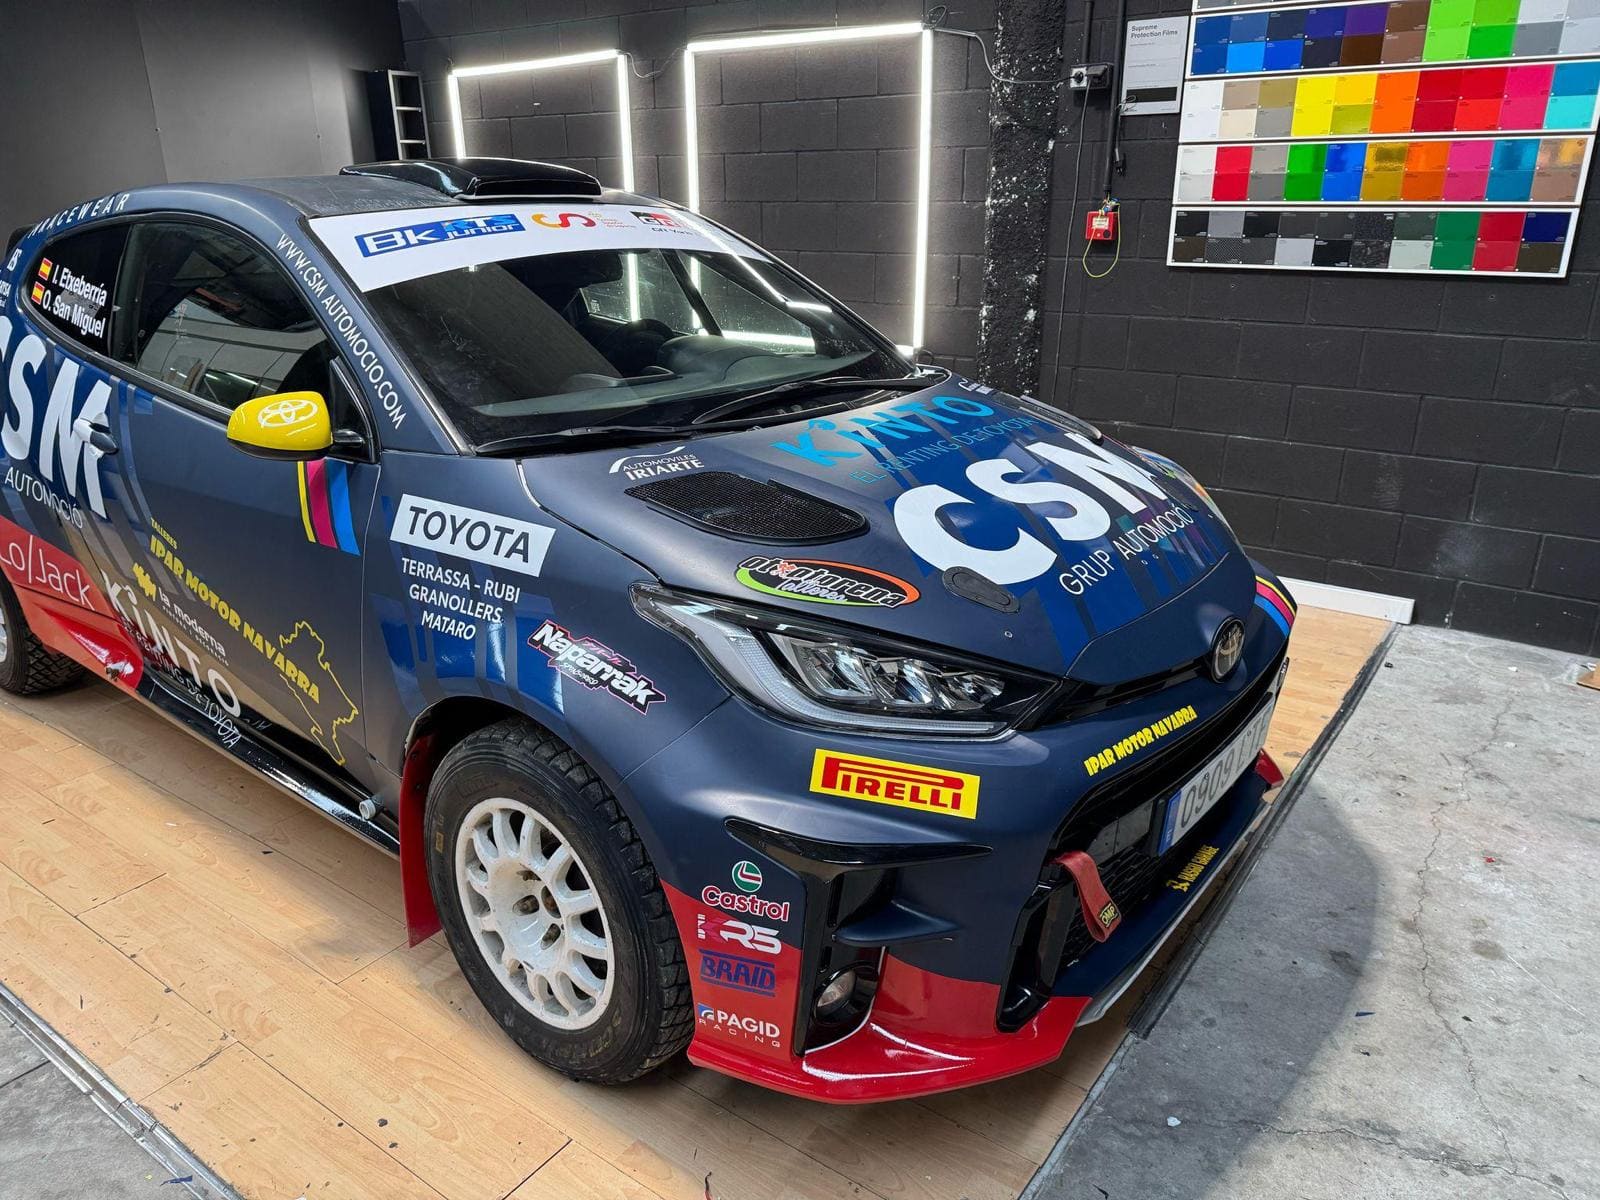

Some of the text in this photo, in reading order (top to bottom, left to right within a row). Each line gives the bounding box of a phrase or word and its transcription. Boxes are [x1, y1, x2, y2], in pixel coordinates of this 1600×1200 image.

[1131, 24, 1158, 32] Supreme
[58, 267, 108, 307] Etxeberría
[42, 289, 52, 312] O.
[53, 294, 71, 321] San
[71, 304, 107, 338] Miguel
[321, 294, 407, 430] AUTOMOCIO.COM
[623, 453, 697, 472] AUTOMOVILES
[625, 459, 705, 480] IRIARTE
[876, 436, 961, 475] RENTING
[893, 432, 1169, 585] CSM
[151, 518, 178, 550] TALLERES
[409, 505, 530, 563] TOYOTA
[1059, 502, 1194, 595] GRUP AUTOMOCIÓ
[401, 557, 471, 591] TERRASSA
[483, 578, 521, 604] RUBI
[150, 535, 185, 579] IPAR
[185, 568, 241, 631] MOTOR
[243, 622, 320, 704] NAVARRA
[409, 583, 504, 624] GRANOLLERS
[173, 602, 227, 657] moderna
[421, 610, 477, 640] MATARO
[532, 623, 658, 706] Naparrak
[1083, 704, 1198, 777] IPAR MOTOR NAVARRA
[821, 756, 964, 811] PIRELLI
[701, 884, 790, 921] Castrol
[700, 956, 777, 991] BRAID
[698, 1017, 781, 1048] RACING
[716, 1009, 780, 1038] PAGID
